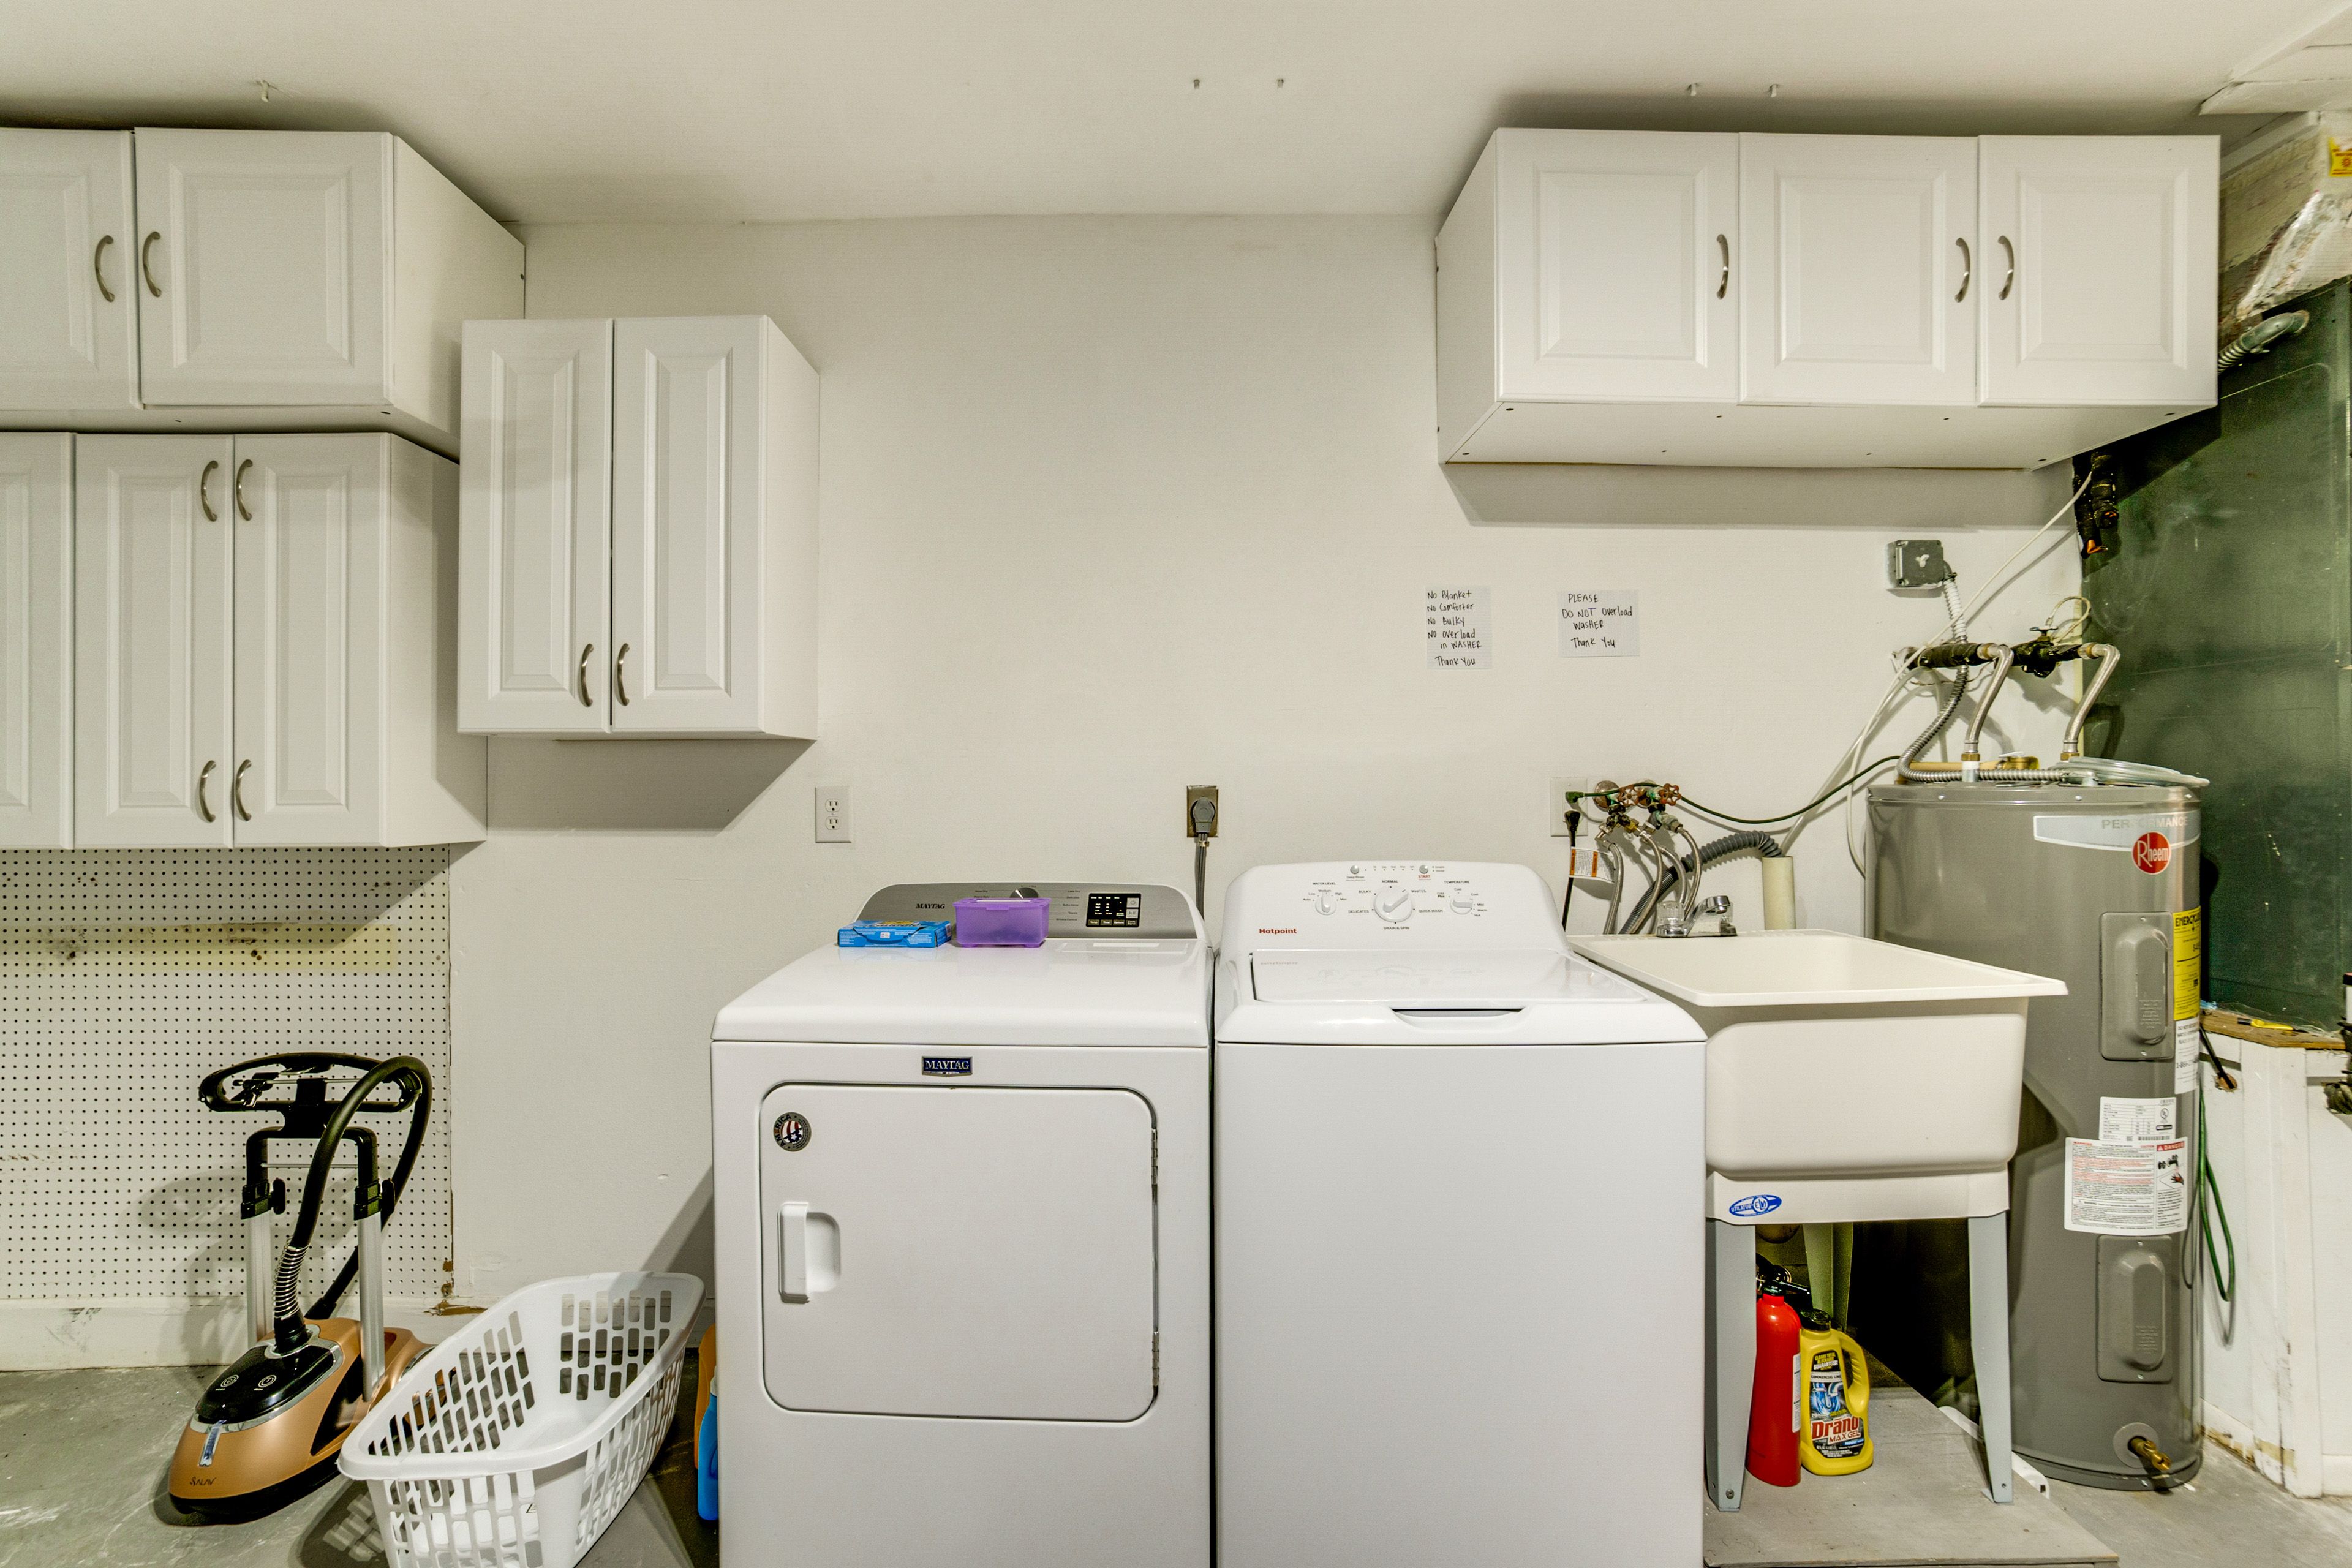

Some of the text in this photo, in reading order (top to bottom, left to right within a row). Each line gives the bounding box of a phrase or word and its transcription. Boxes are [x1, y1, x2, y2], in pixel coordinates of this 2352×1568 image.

[1441, 590, 1472, 600] Blanket
[1568, 593, 1599, 603] PLEASE
[1439, 602, 1474, 611] Comforter
[1562, 609, 1574, 619] DO
[1578, 607, 1596, 617] NOT
[1451, 640, 1482, 649] WASHER
[1570, 637, 1615, 648] Thank You
[1434, 655, 1476, 666] Thank You
[2101, 816, 2188, 829] PERFORMANCE
[2136, 833, 2169, 868] Rheem
[925, 1060, 970, 1069] MAYTAG
[774, 1114, 792, 1147] AMERICA
[2164, 1142, 2185, 1151] DANGER
[1829, 1433, 1847, 1443] MAX
[1847, 1430, 1860, 1439] GEL
